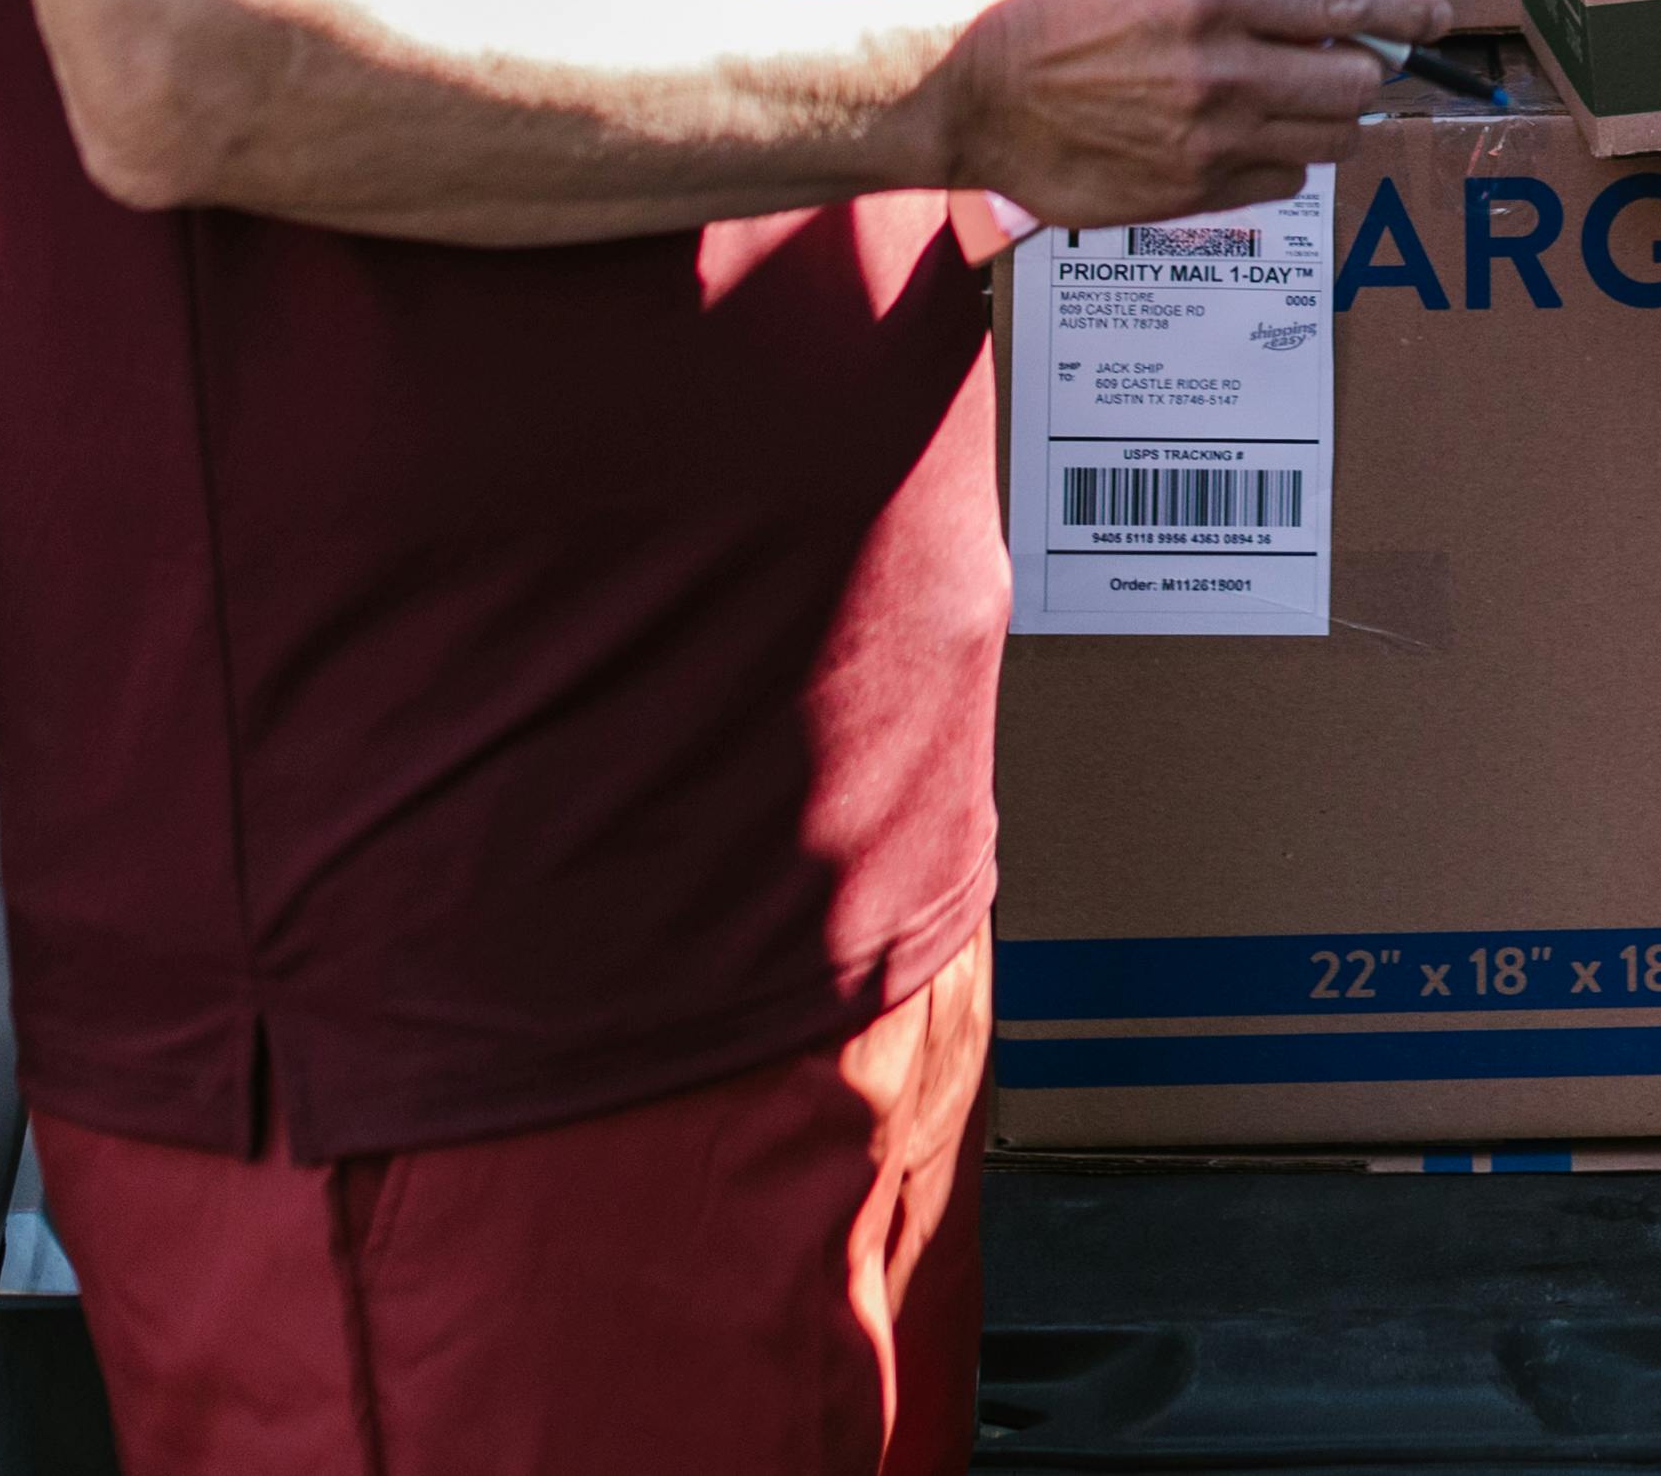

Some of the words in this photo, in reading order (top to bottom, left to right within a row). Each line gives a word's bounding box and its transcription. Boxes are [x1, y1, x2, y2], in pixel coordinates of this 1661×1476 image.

[1059, 263, 1162, 281] PRIORITY
[1170, 265, 1222, 282] MAIL
[1060, 291, 1112, 302] MARKY'S
[1115, 292, 1154, 302] STORE
[1285, 296, 1316, 306] 0005
[1059, 303, 1083, 314] 609
[1085, 303, 1136, 315] CASTLE
[1141, 304, 1182, 316] RIDGE
[1185, 305, 1205, 316] RD
[1059, 317, 1108, 328] AUSTIN
[1113, 318, 1128, 329] TX
[1249, 321, 1317, 341] shipping
[1270, 334, 1301, 347] easy
[1058, 362, 1081, 370] SHIP
[1096, 363, 1128, 374] JACK
[1133, 363, 1163, 374] SHIP
[1058, 373, 1074, 381] TO:
[1095, 377, 1117, 388] 609
[1121, 378, 1172, 389] CASTLE
[1176, 379, 1217, 390] RIDGE
[1221, 379, 1240, 390] RD
[1095, 393, 1143, 404] AUSTIN
[1148, 394, 1165, 405] TX
[1123, 448, 1159, 459] USPS
[1164, 449, 1231, 461] TRACKING
[1236, 450, 1244, 461] #
[1125, 532, 1153, 543] 5118
[1109, 578, 1156, 591] Order:
[1309, 949, 1402, 1000] 22"
[1420, 961, 1452, 997] x
[1470, 946, 1553, 996] 18"
[1570, 957, 1602, 994] x
